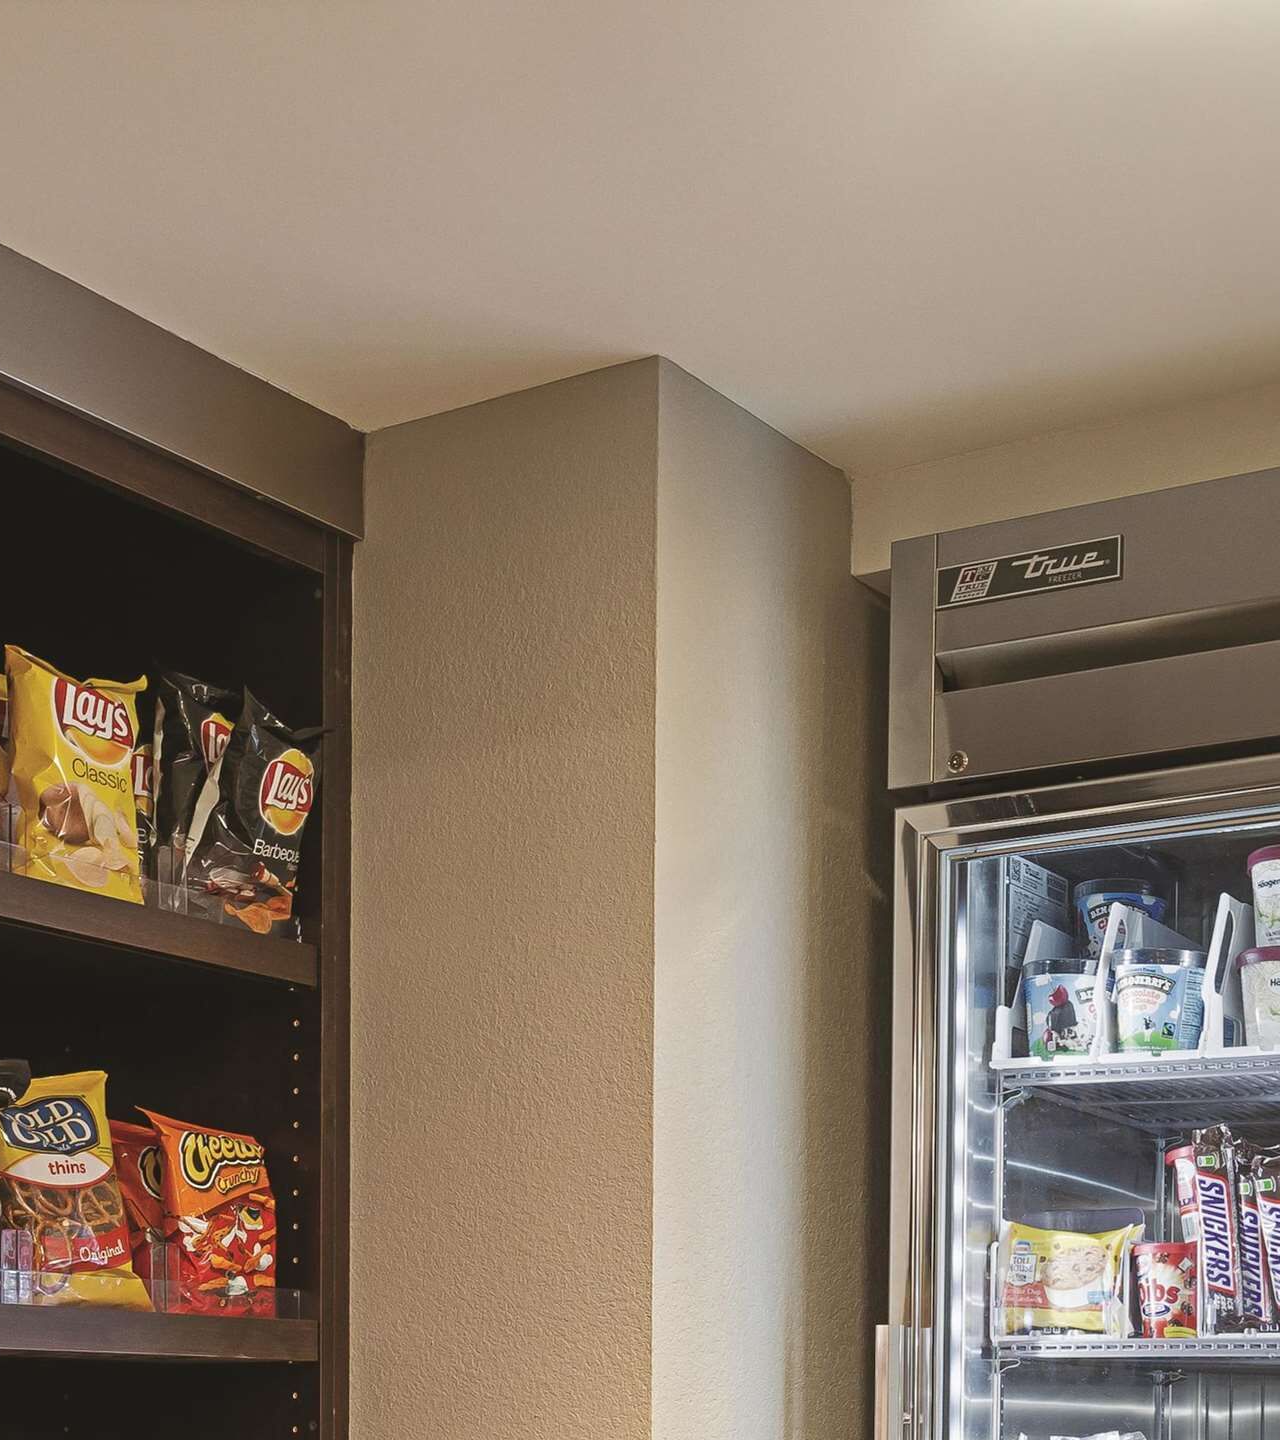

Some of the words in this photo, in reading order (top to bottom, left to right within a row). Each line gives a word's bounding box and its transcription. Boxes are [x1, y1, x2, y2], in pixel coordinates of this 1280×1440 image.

[1048, 571, 1082, 583] FREEZER
[62, 682, 129, 740] Lay's
[72, 758, 127, 793] Classic
[265, 763, 310, 810] Lay's
[48, 1161, 87, 1175] thins
[216, 1168, 259, 1193] Crunchy
[1198, 1179, 1231, 1287] SNICKERS
[79, 1240, 125, 1265] Original
[1240, 1211, 1263, 1318] SNICKERS
